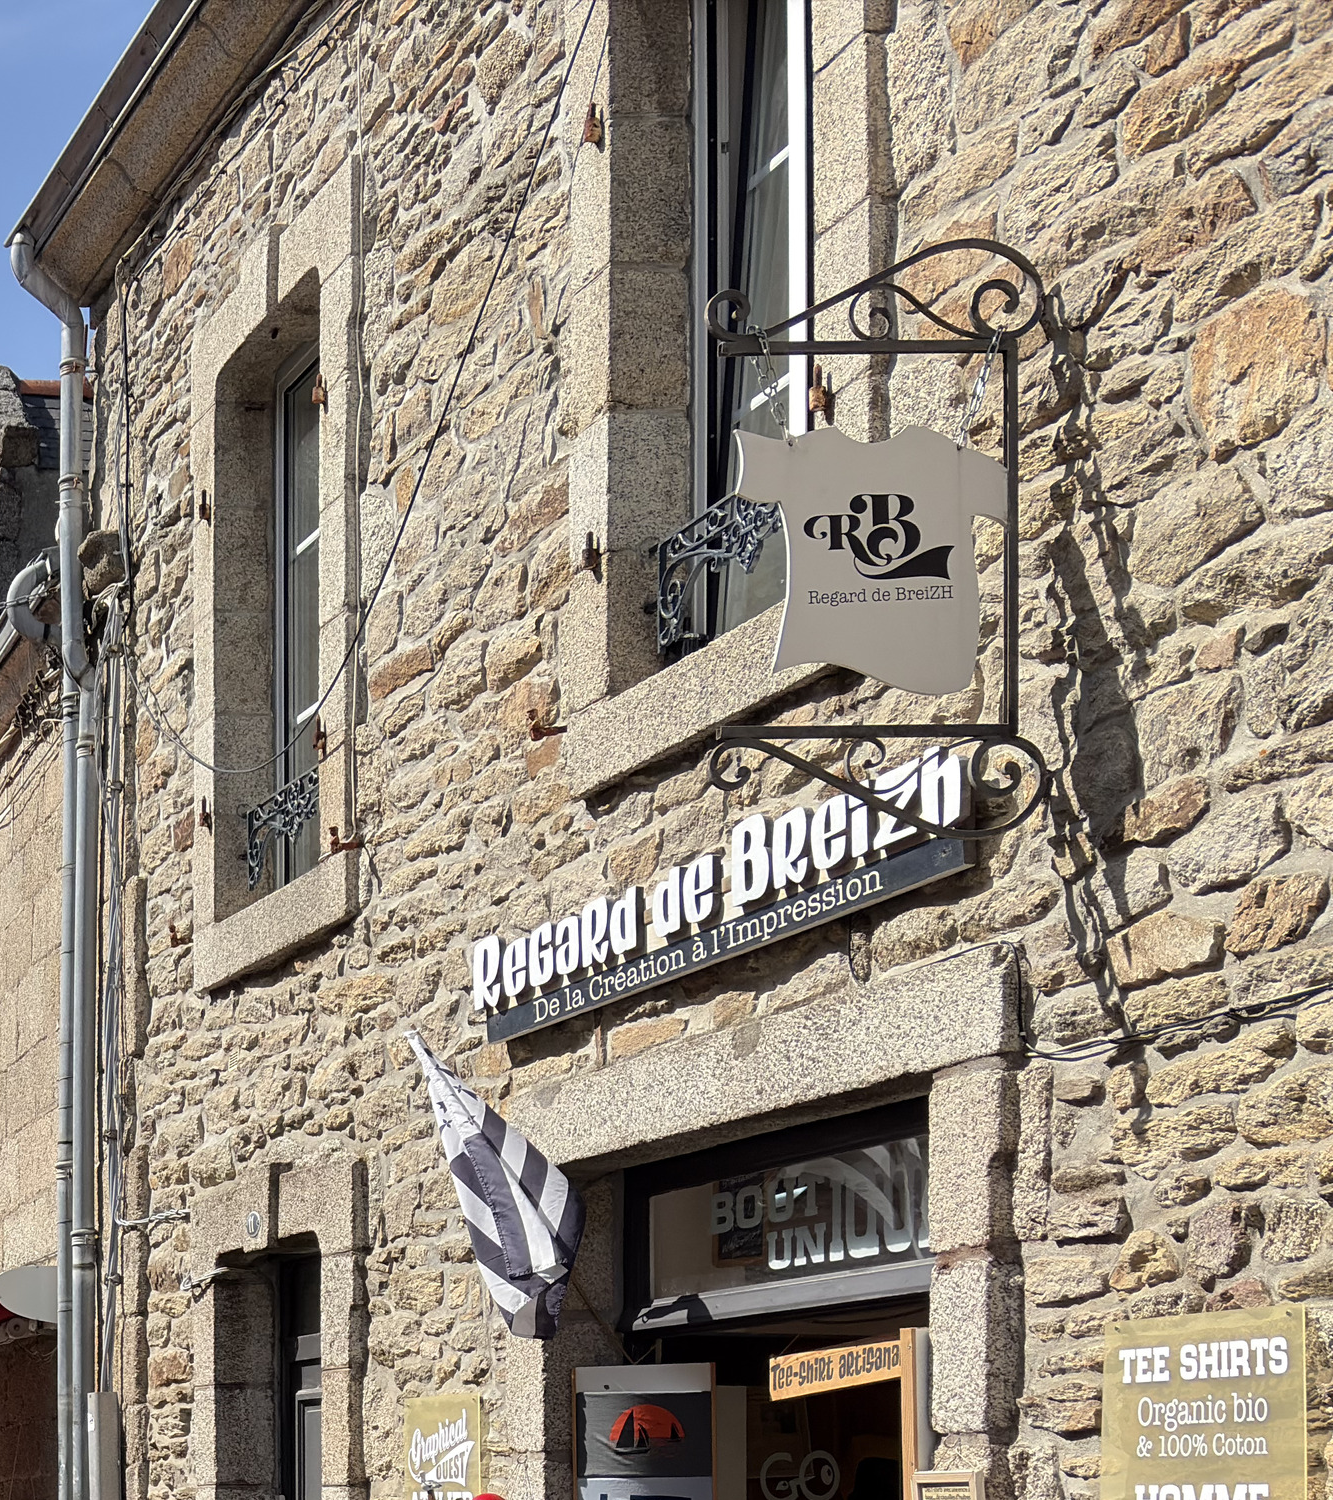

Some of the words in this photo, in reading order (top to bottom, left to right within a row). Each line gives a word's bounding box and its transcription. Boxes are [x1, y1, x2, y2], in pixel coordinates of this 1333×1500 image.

[808, 589, 867, 607] Regard
[872, 588, 891, 601] de
[895, 585, 954, 601] BreiZH
[652, 853, 716, 937] de
[533, 993, 560, 1024] De
[563, 986, 585, 1013] la
[589, 951, 686, 1003] Création
[692, 936, 707, 965] à
[1119, 1347, 1170, 1384] TEE
[1180, 1336, 1289, 1381] SHIRTS
[1137, 1397, 1226, 1432] Organic
[1233, 1392, 1268, 1423] bio
[411, 1408, 468, 1471] Graphical
[1136, 1437, 1153, 1457] &
[1158, 1434, 1208, 1457] 100%
[1212, 1433, 1268, 1456] Coton
[436, 1451, 466, 1480] OUEST
